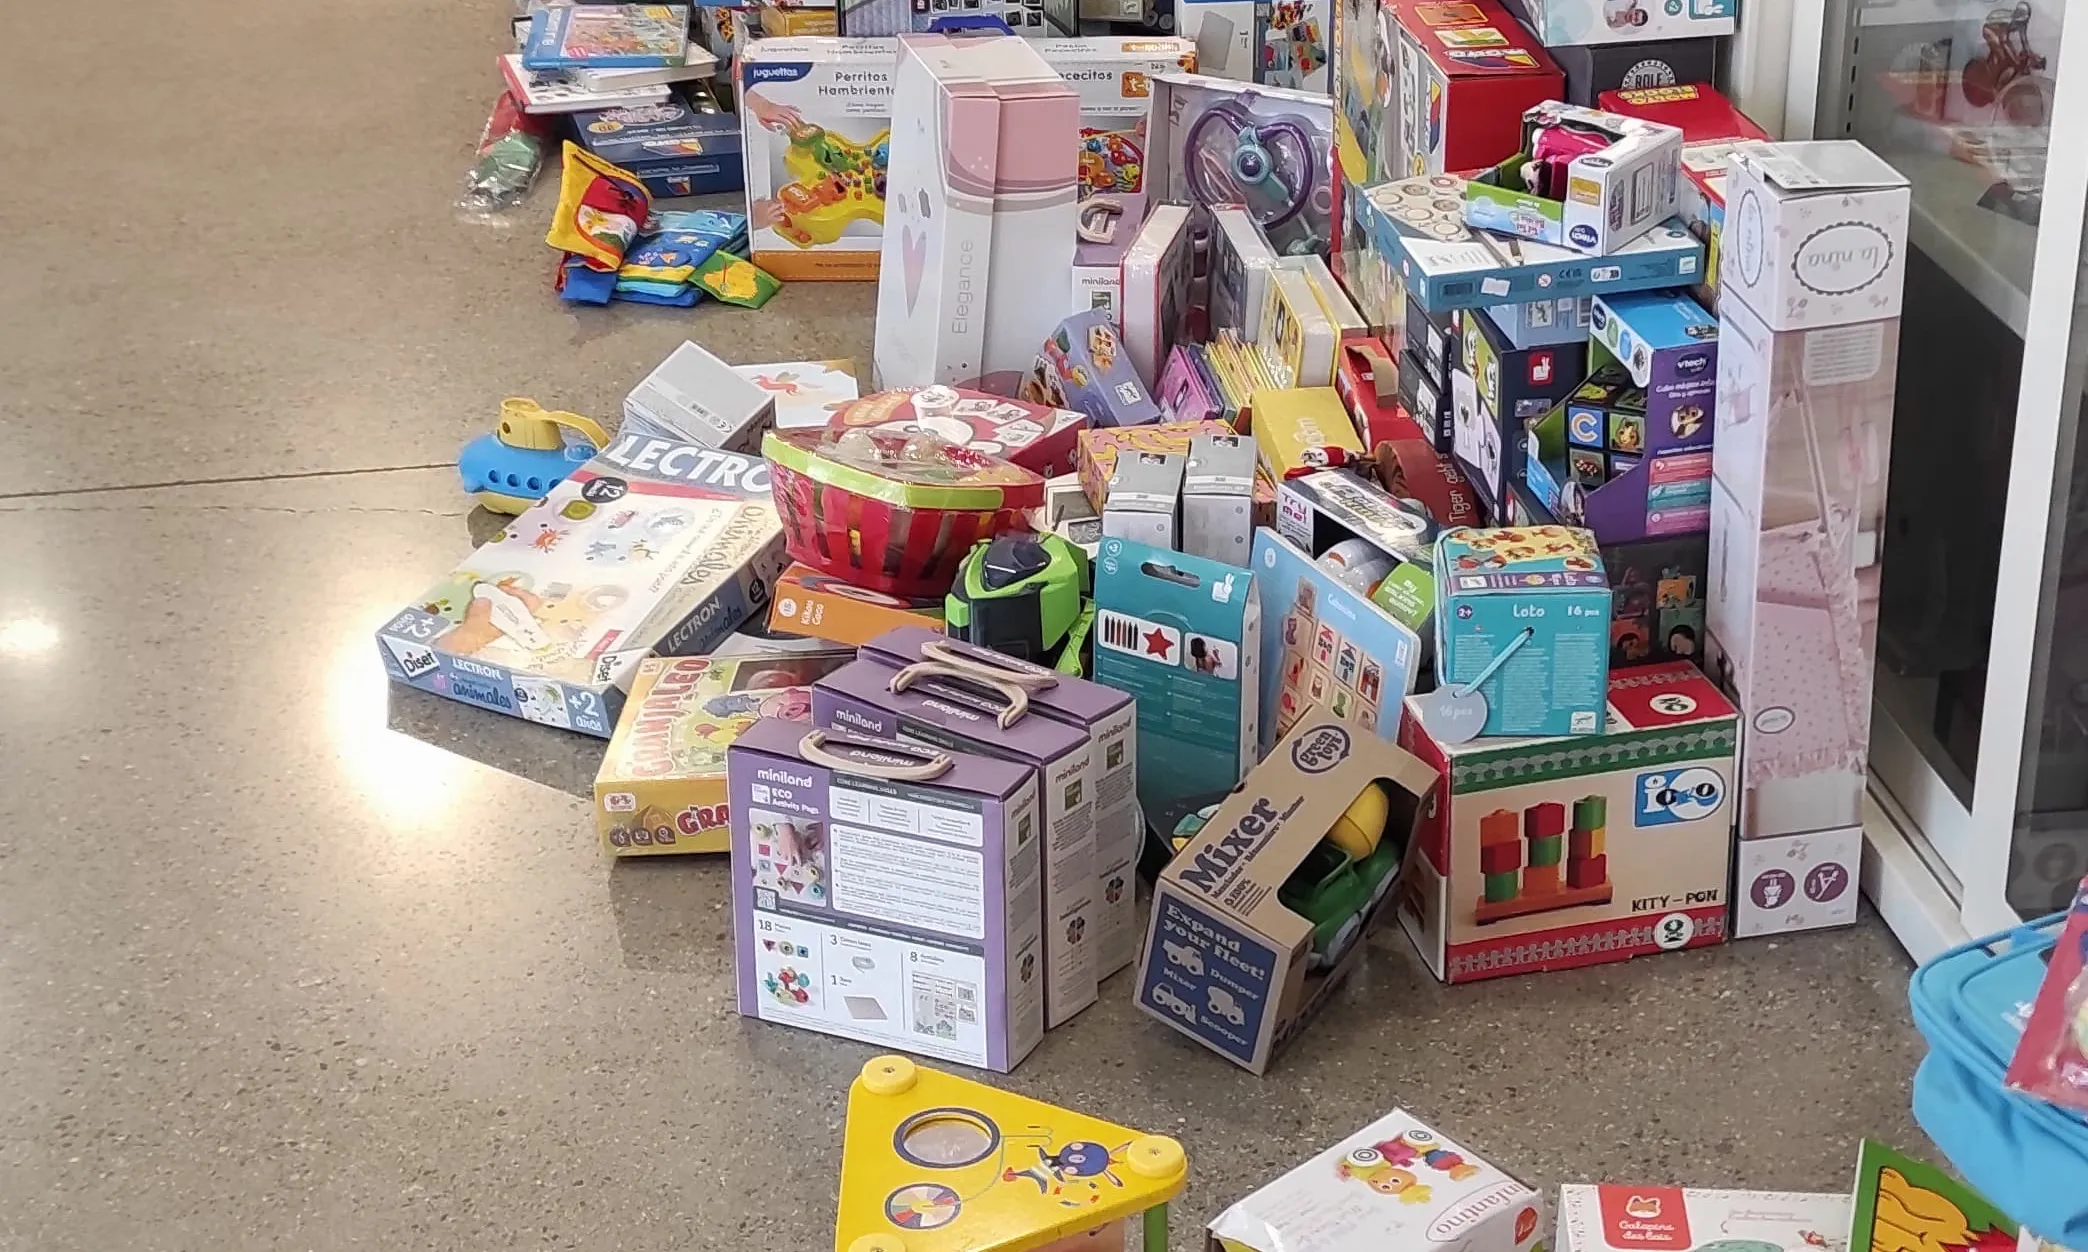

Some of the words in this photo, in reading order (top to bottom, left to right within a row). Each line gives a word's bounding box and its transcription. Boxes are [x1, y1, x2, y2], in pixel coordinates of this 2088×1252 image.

[835, 70, 888, 82] Perritos
[951, 240, 974, 335] Elegance
[1449, 488, 1472, 523] Tiger
[666, 594, 721, 653] LECTRON
[1513, 604, 1546, 618] Loto
[1567, 605, 1582, 616] 16
[403, 650, 437, 674] Diset
[452, 657, 504, 681] LECTRON
[453, 681, 513, 710] animales
[569, 690, 600, 717] +2
[835, 709, 882, 733] miniland
[1098, 715, 1132, 743] miniland
[848, 750, 915, 767] miniland
[1299, 731, 1332, 767] green
[1316, 735, 1343, 761] toys
[757, 768, 813, 788] miniland
[1055, 753, 1090, 784] miniland
[771, 787, 793, 800] ECO
[772, 798, 800, 812] Activity
[1179, 797, 1279, 894] Mixer
[758, 919, 773, 932] 18
[1166, 903, 1241, 953] Expand
[830, 934, 838, 946] 3
[1163, 919, 1211, 949] your
[1214, 944, 1265, 981] fleet!
[910, 951, 918, 963] 8
[832, 974, 838, 986] 1
[1163, 967, 1197, 991] Mixer
[1210, 967, 1260, 1000] Dumper
[1200, 1015, 1249, 1046] Scooper
